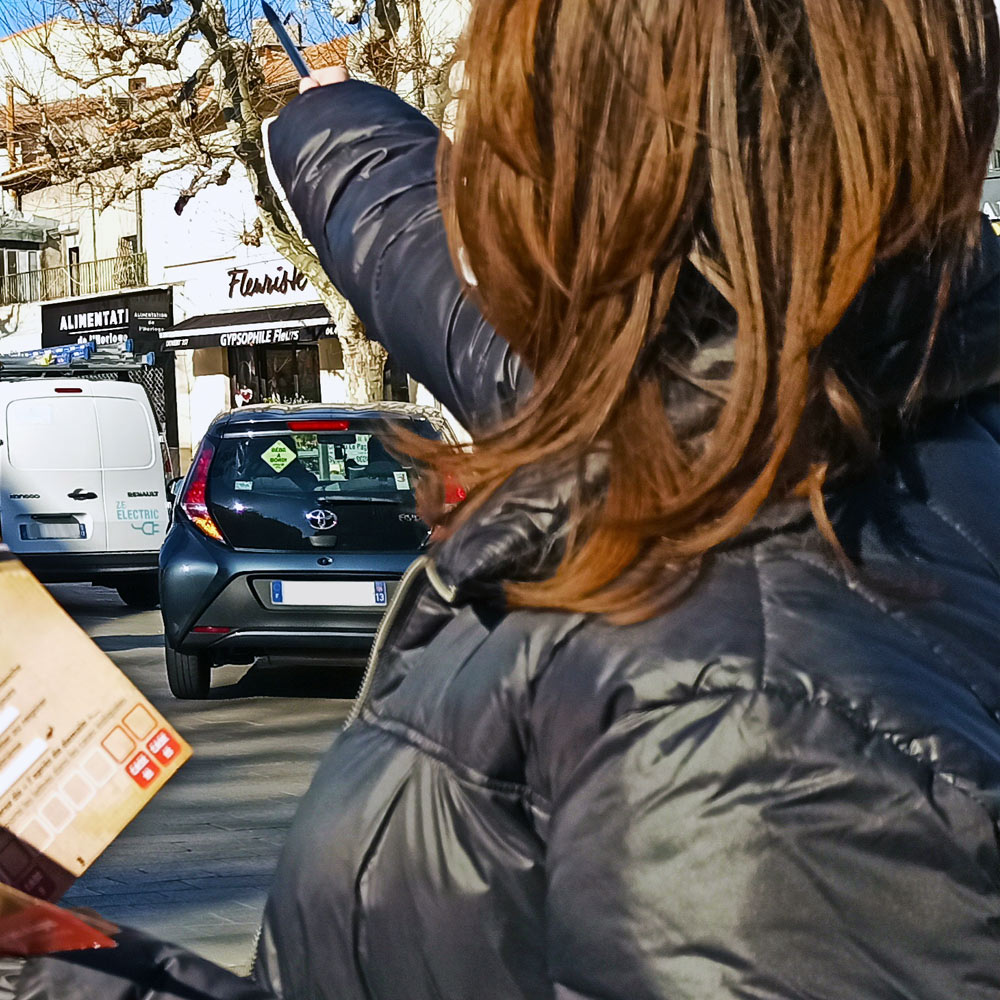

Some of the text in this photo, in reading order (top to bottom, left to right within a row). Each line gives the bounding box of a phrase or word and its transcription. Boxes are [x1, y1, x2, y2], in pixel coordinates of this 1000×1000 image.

[227, 266, 308, 298] Fleuriste
[220, 330, 272, 347] GYPSOPHILE
[117, 509, 159, 520] ELECTRIC
[375, 593, 385, 602] 13
